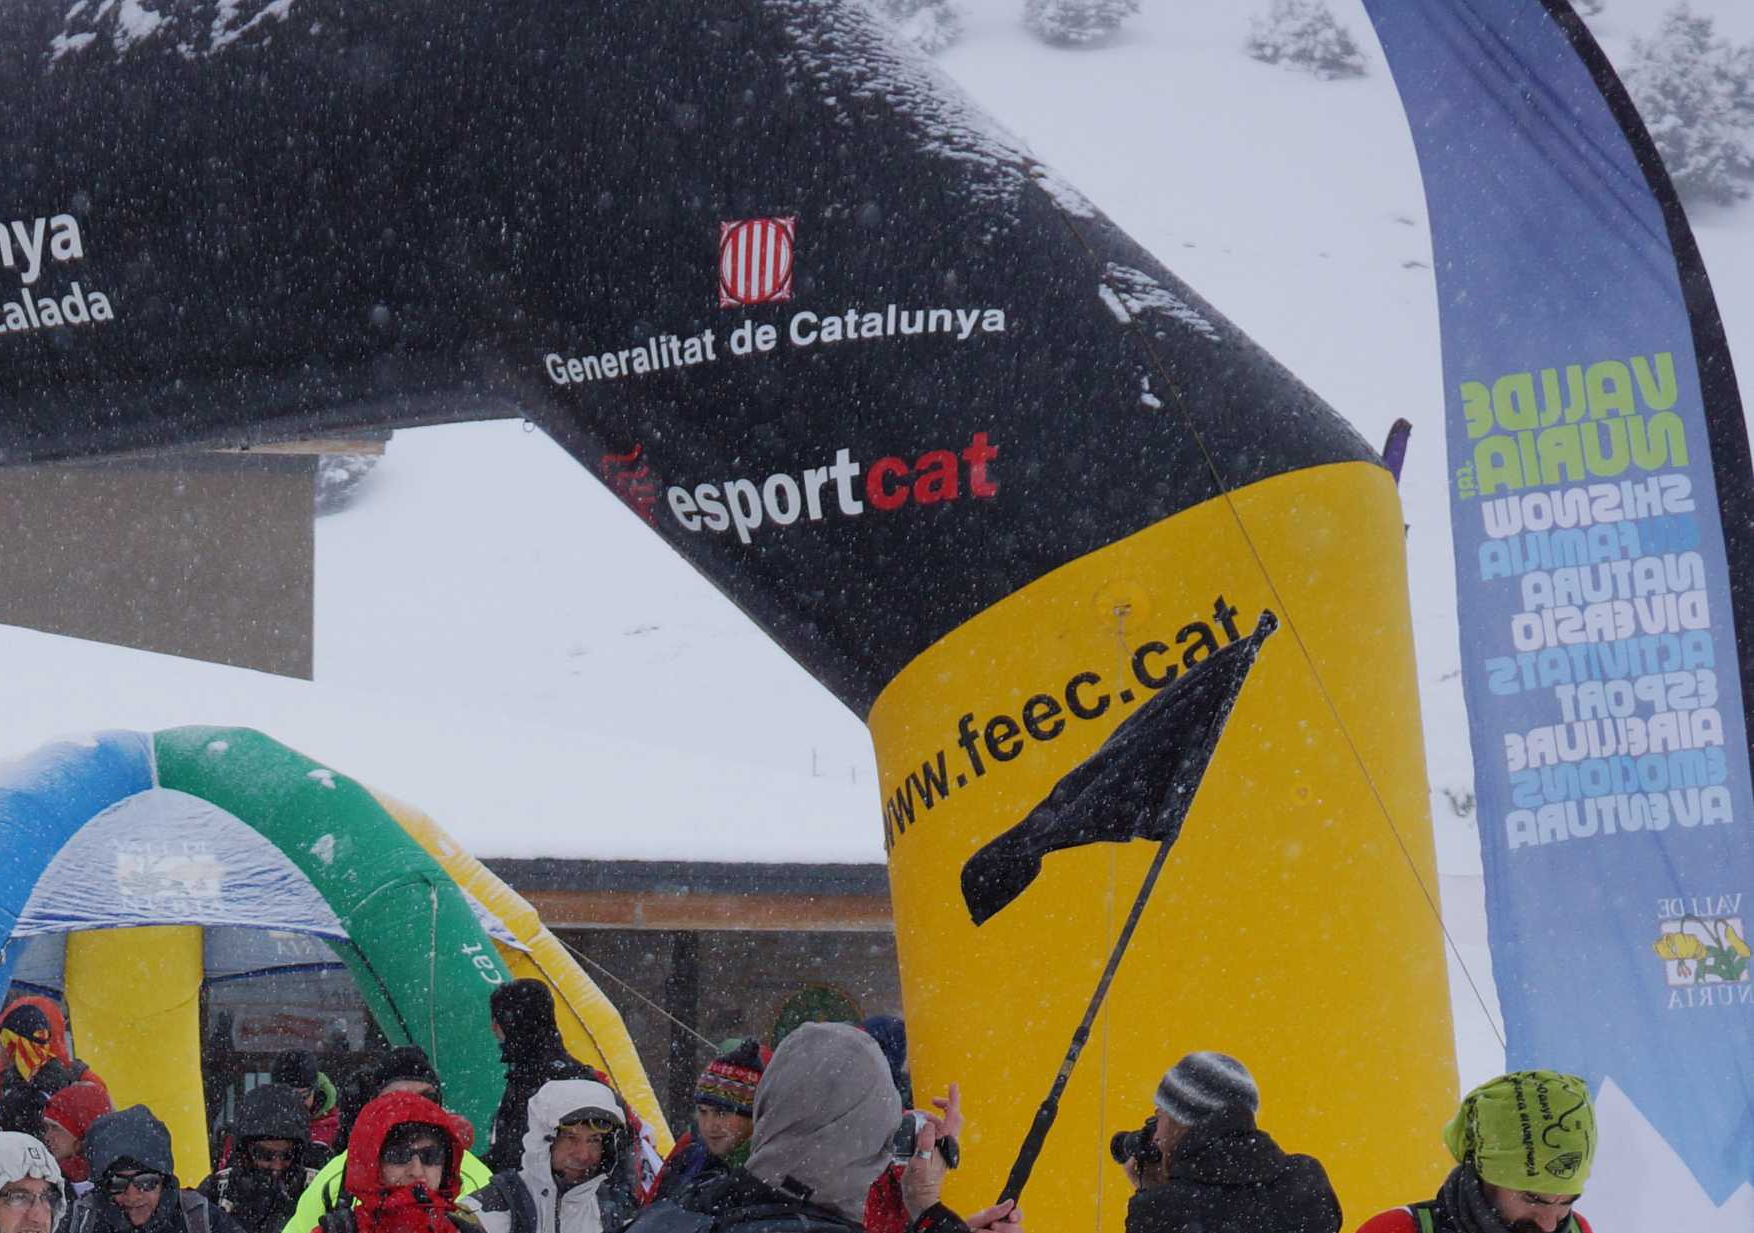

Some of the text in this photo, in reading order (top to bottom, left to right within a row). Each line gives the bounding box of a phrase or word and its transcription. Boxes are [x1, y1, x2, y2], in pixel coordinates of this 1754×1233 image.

[546, 304, 1006, 385] Generalitat de Catalunya
